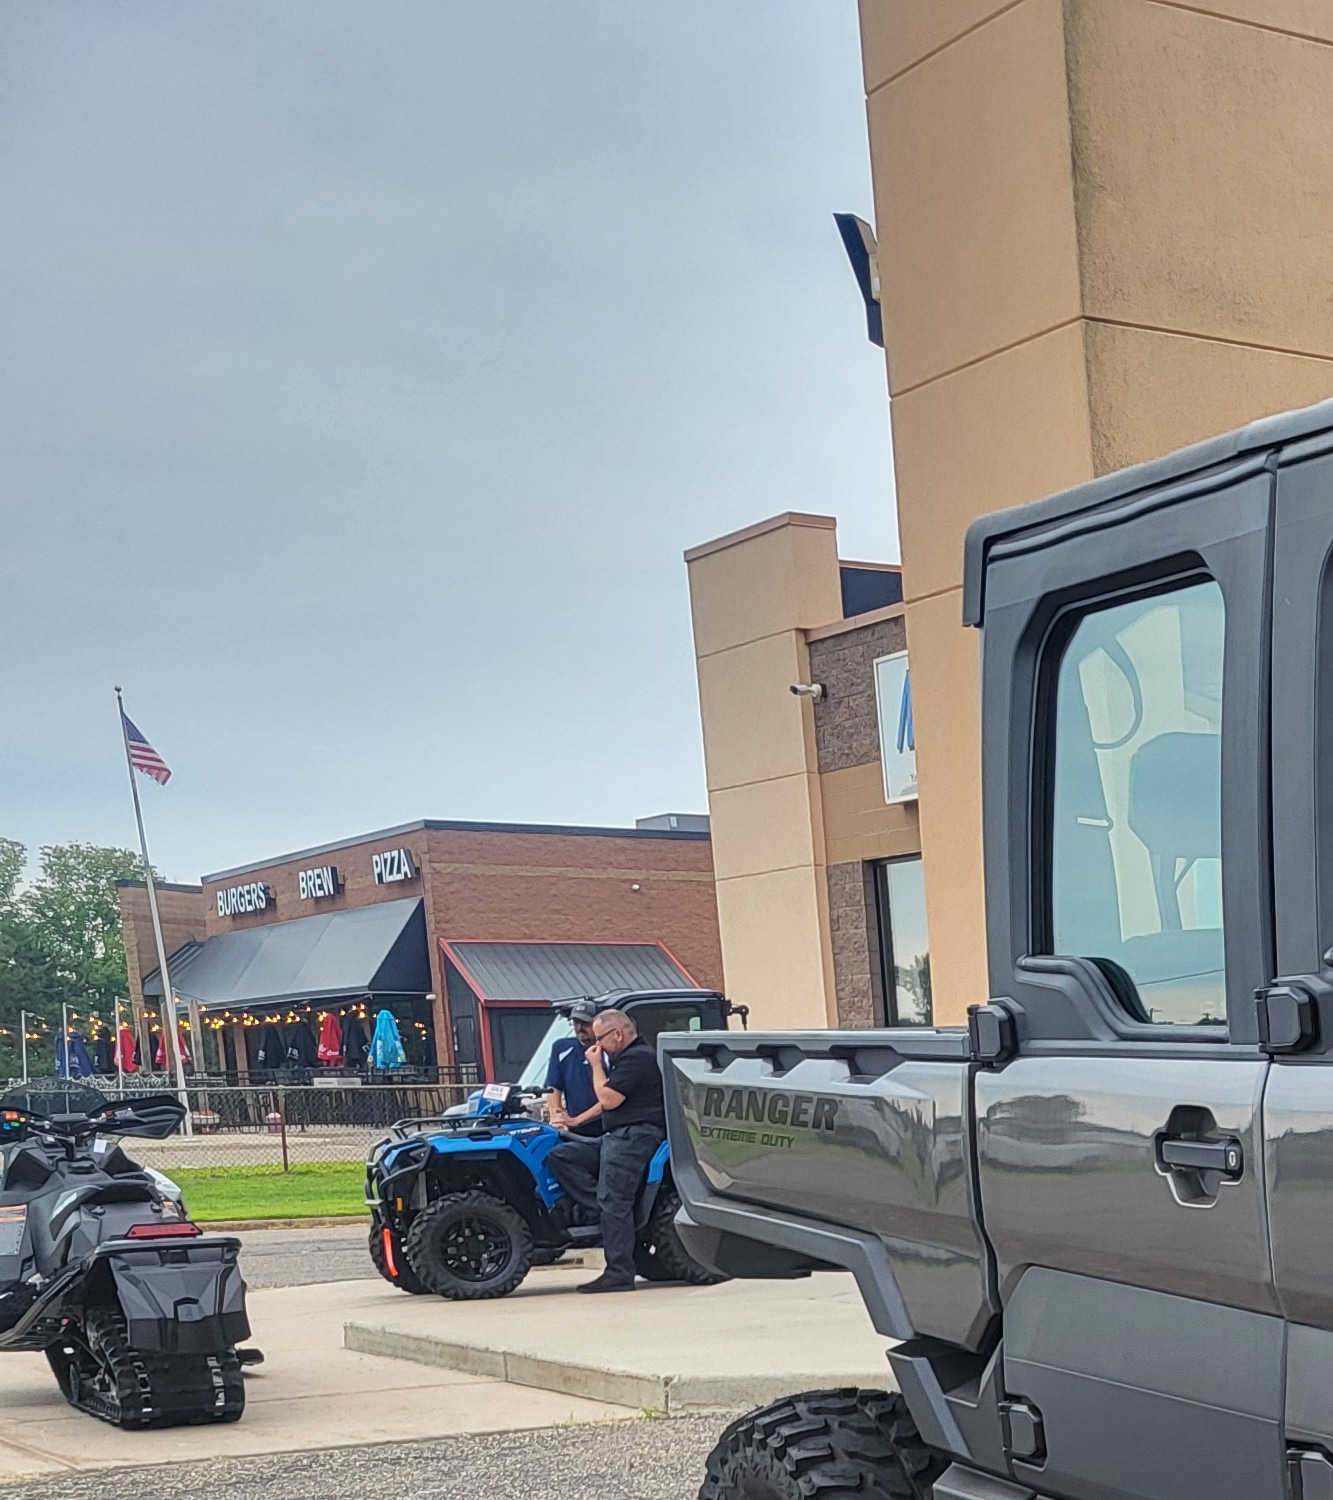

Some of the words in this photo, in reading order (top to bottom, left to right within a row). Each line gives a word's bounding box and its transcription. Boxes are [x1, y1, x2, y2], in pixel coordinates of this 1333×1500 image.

[298, 866, 335, 900] BREW
[371, 848, 412, 885] PIZZA
[216, 881, 266, 917] BURGERS
[703, 1086, 839, 1131] RANGER
[700, 1125, 758, 1144] EXTREME
[760, 1133, 795, 1148] DUTY
